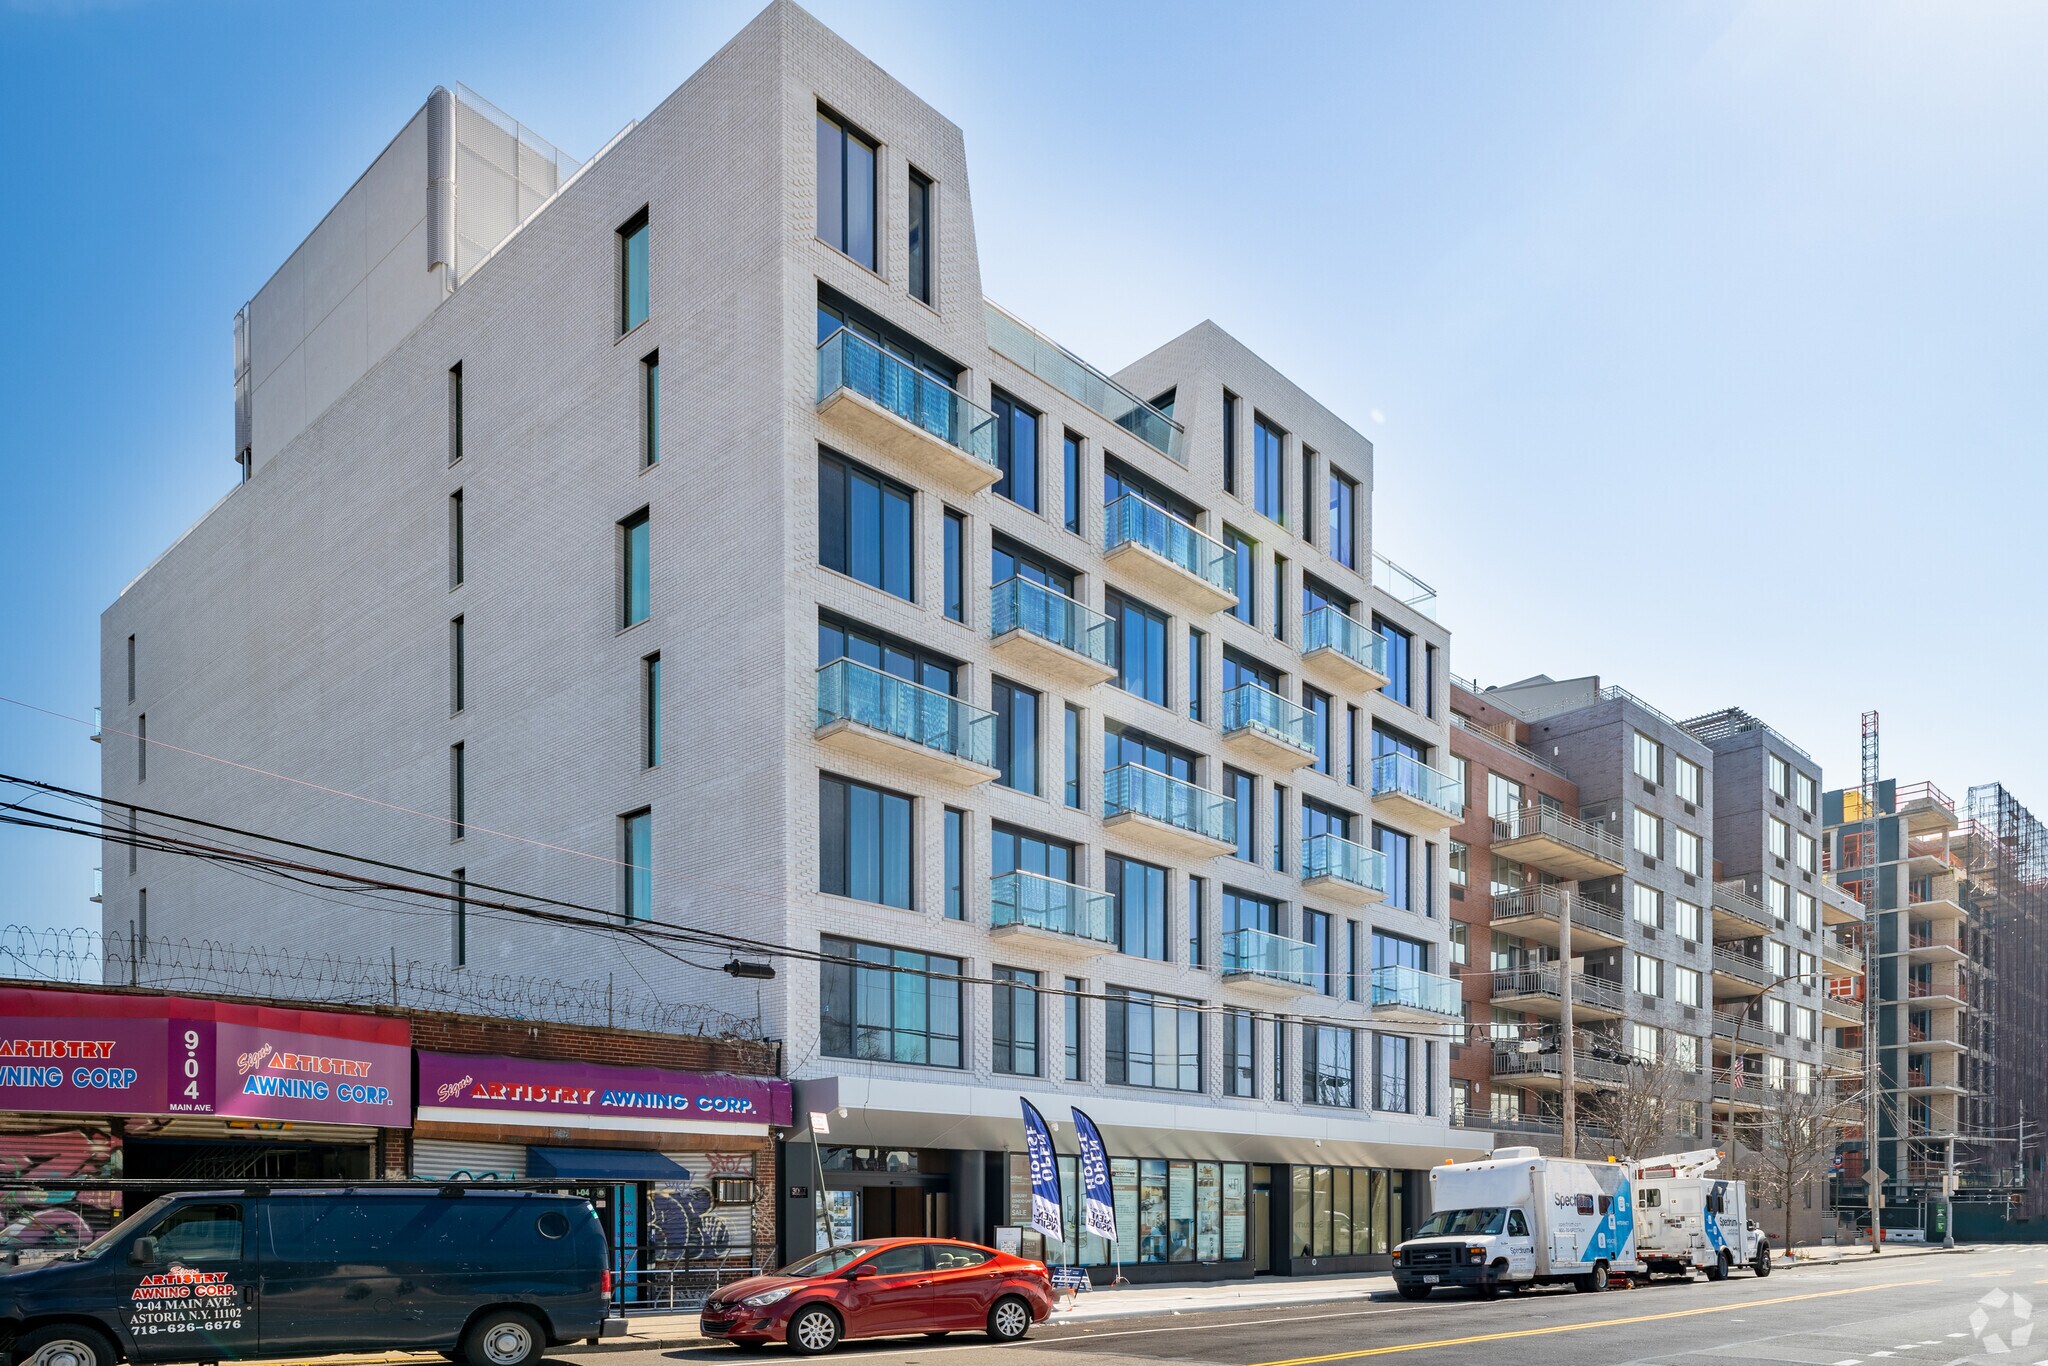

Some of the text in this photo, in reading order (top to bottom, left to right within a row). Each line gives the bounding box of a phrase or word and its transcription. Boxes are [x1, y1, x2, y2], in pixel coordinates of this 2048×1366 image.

[0, 1039, 116, 1059] ARTISTRY
[237, 1043, 373, 1077] Signs ARTISTRY
[72, 1067, 138, 1089] CORP
[242, 1074, 393, 1105] AWNING CORP.
[437, 1074, 757, 1115] Signs ARTISTRY AWNING CORP.
[194, 1104, 214, 1112] AVE.
[140, 1272, 228, 1286] ARTISTRY
[131, 1284, 238, 1300] AWNING CORP.
[136, 1297, 235, 1312] 9-04 MAIN AVE.
[130, 1308, 242, 1325] ASTORIA N.Y. 11102
[131, 1320, 241, 1336] 718-626-6676
